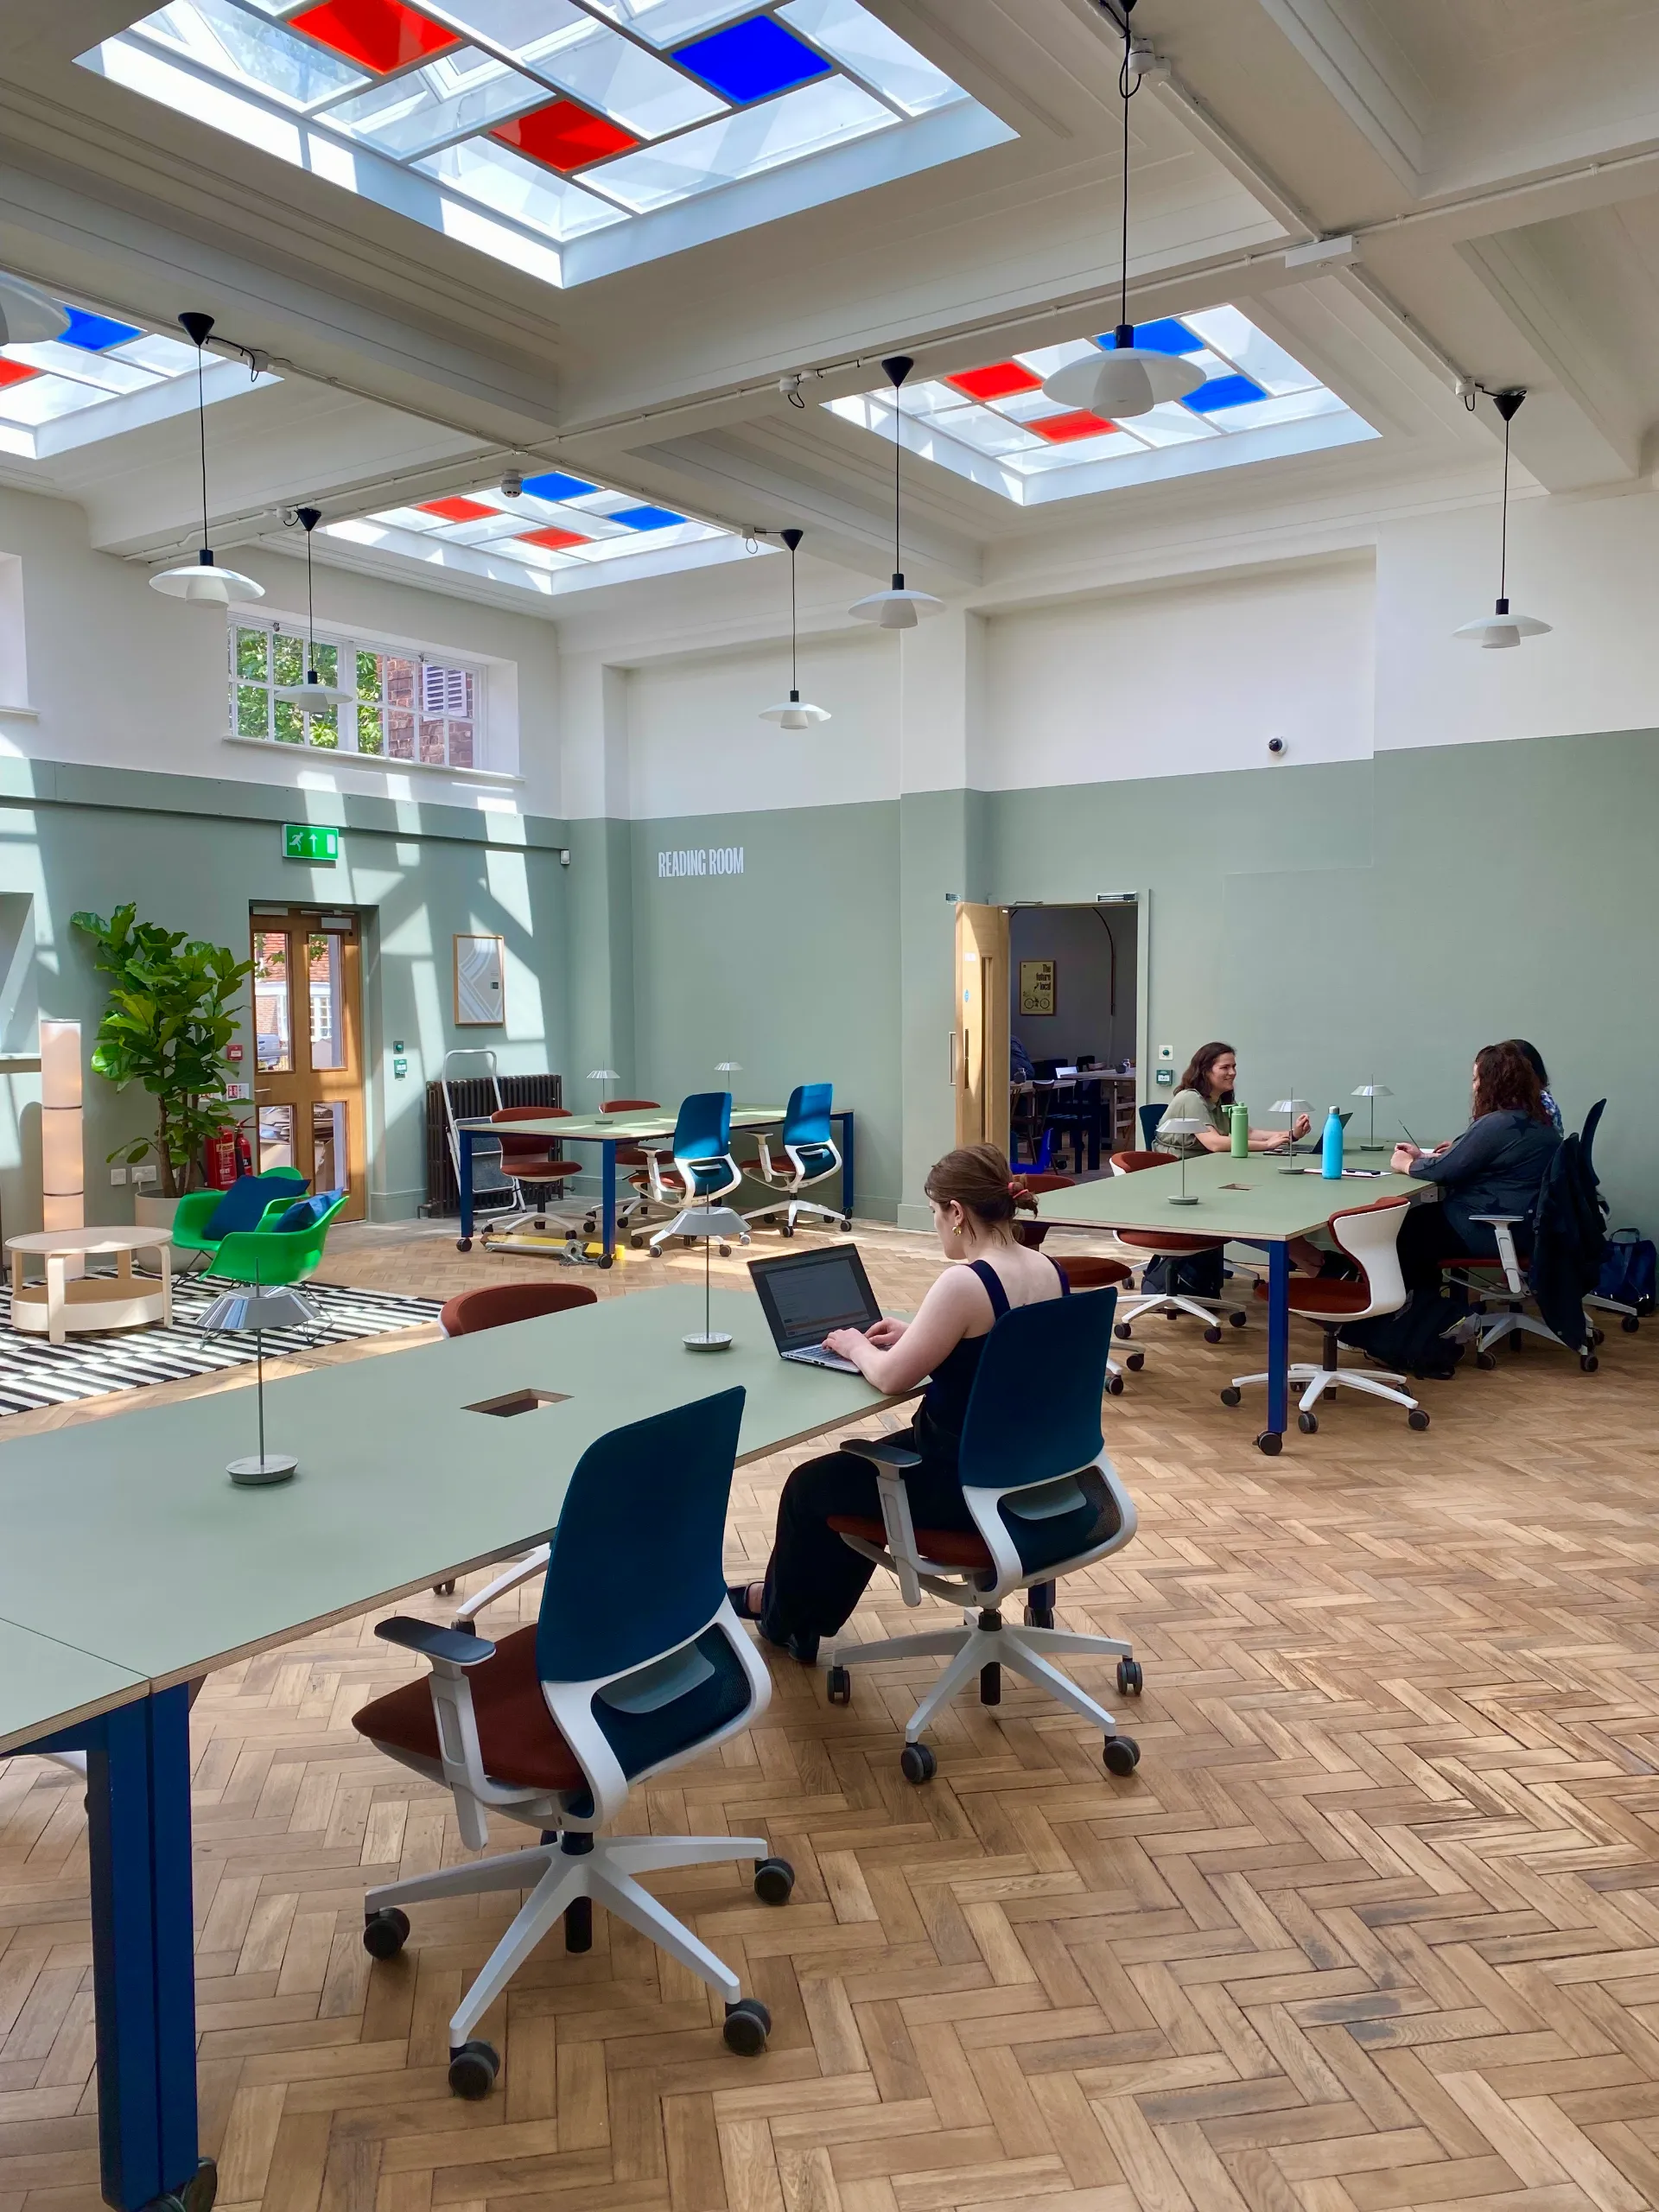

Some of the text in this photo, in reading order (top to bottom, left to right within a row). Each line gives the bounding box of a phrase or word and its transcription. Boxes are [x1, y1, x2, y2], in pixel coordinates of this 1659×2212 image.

[658, 847, 743, 877] READING ROOM
[1042, 963, 1051, 973] The
[1036, 972, 1051, 981] future
[1039, 982, 1051, 990] local
